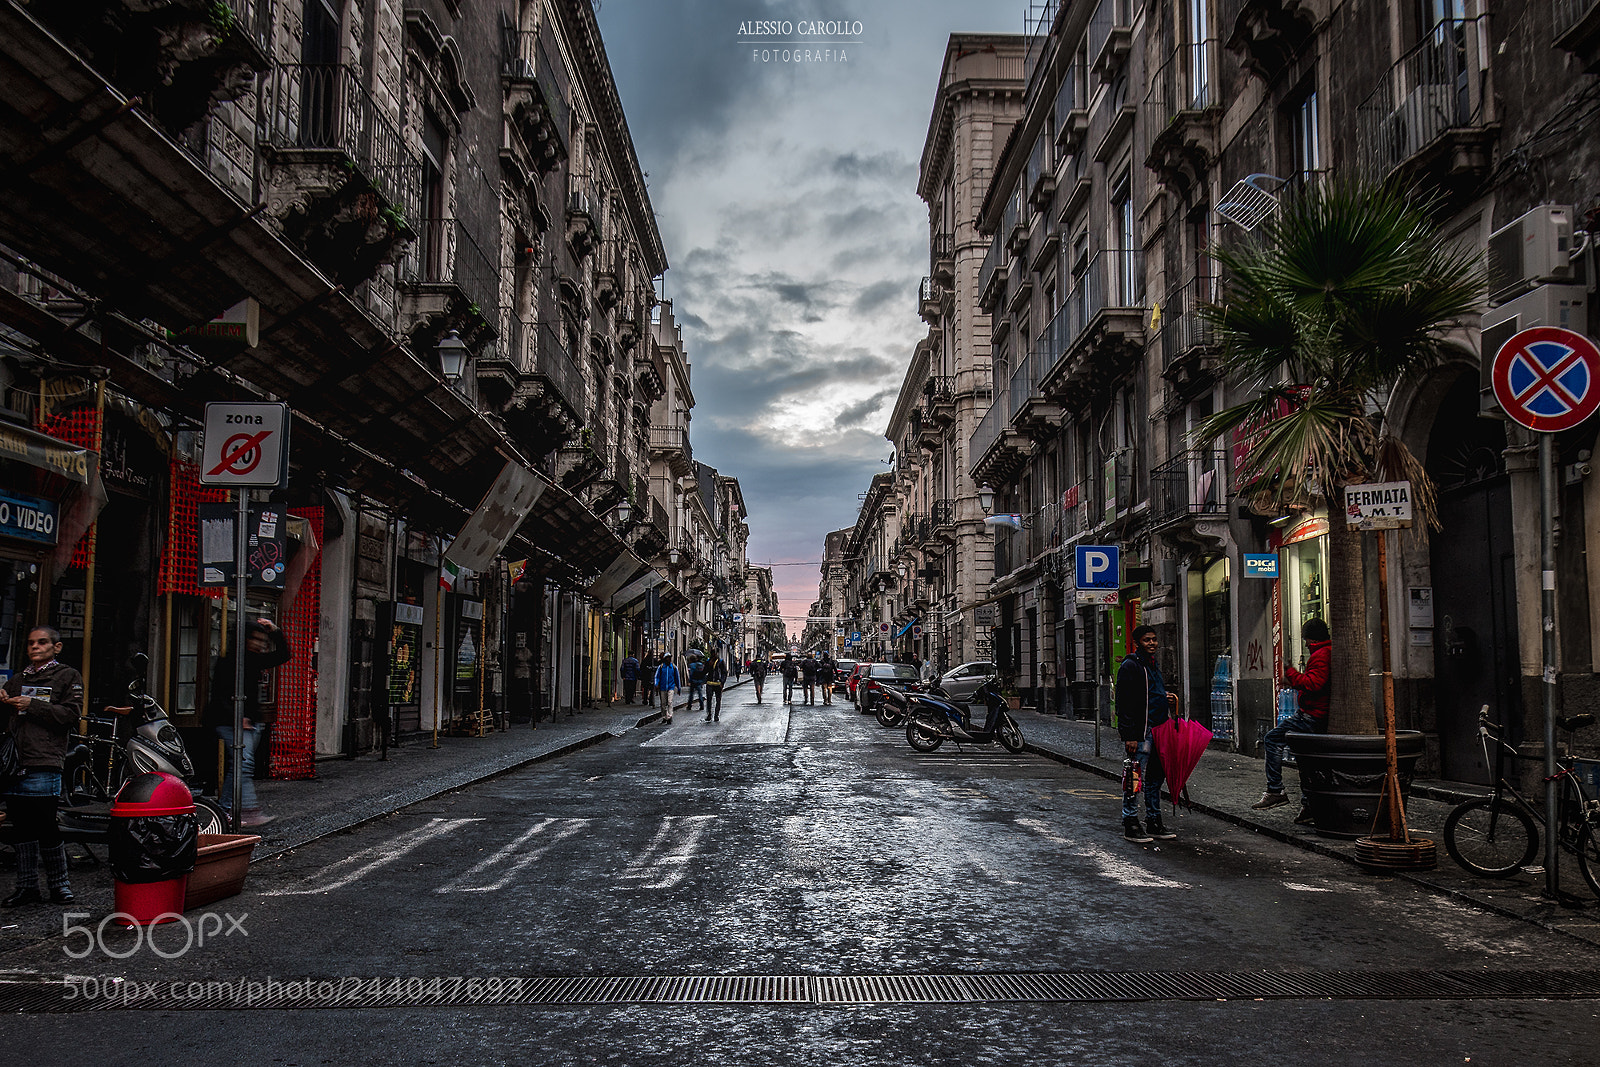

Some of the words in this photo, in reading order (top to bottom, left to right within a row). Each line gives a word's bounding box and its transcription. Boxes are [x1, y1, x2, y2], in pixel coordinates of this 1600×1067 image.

[225, 414, 263, 425] zona
[45, 447, 87, 477] PHOTO
[1346, 488, 1408, 506] FERMATA
[16, 505, 54, 535] VIDEO
[1085, 551, 1110, 583] P
[1246, 559, 1276, 567] DIGI
[845, 639, 851, 647] P
